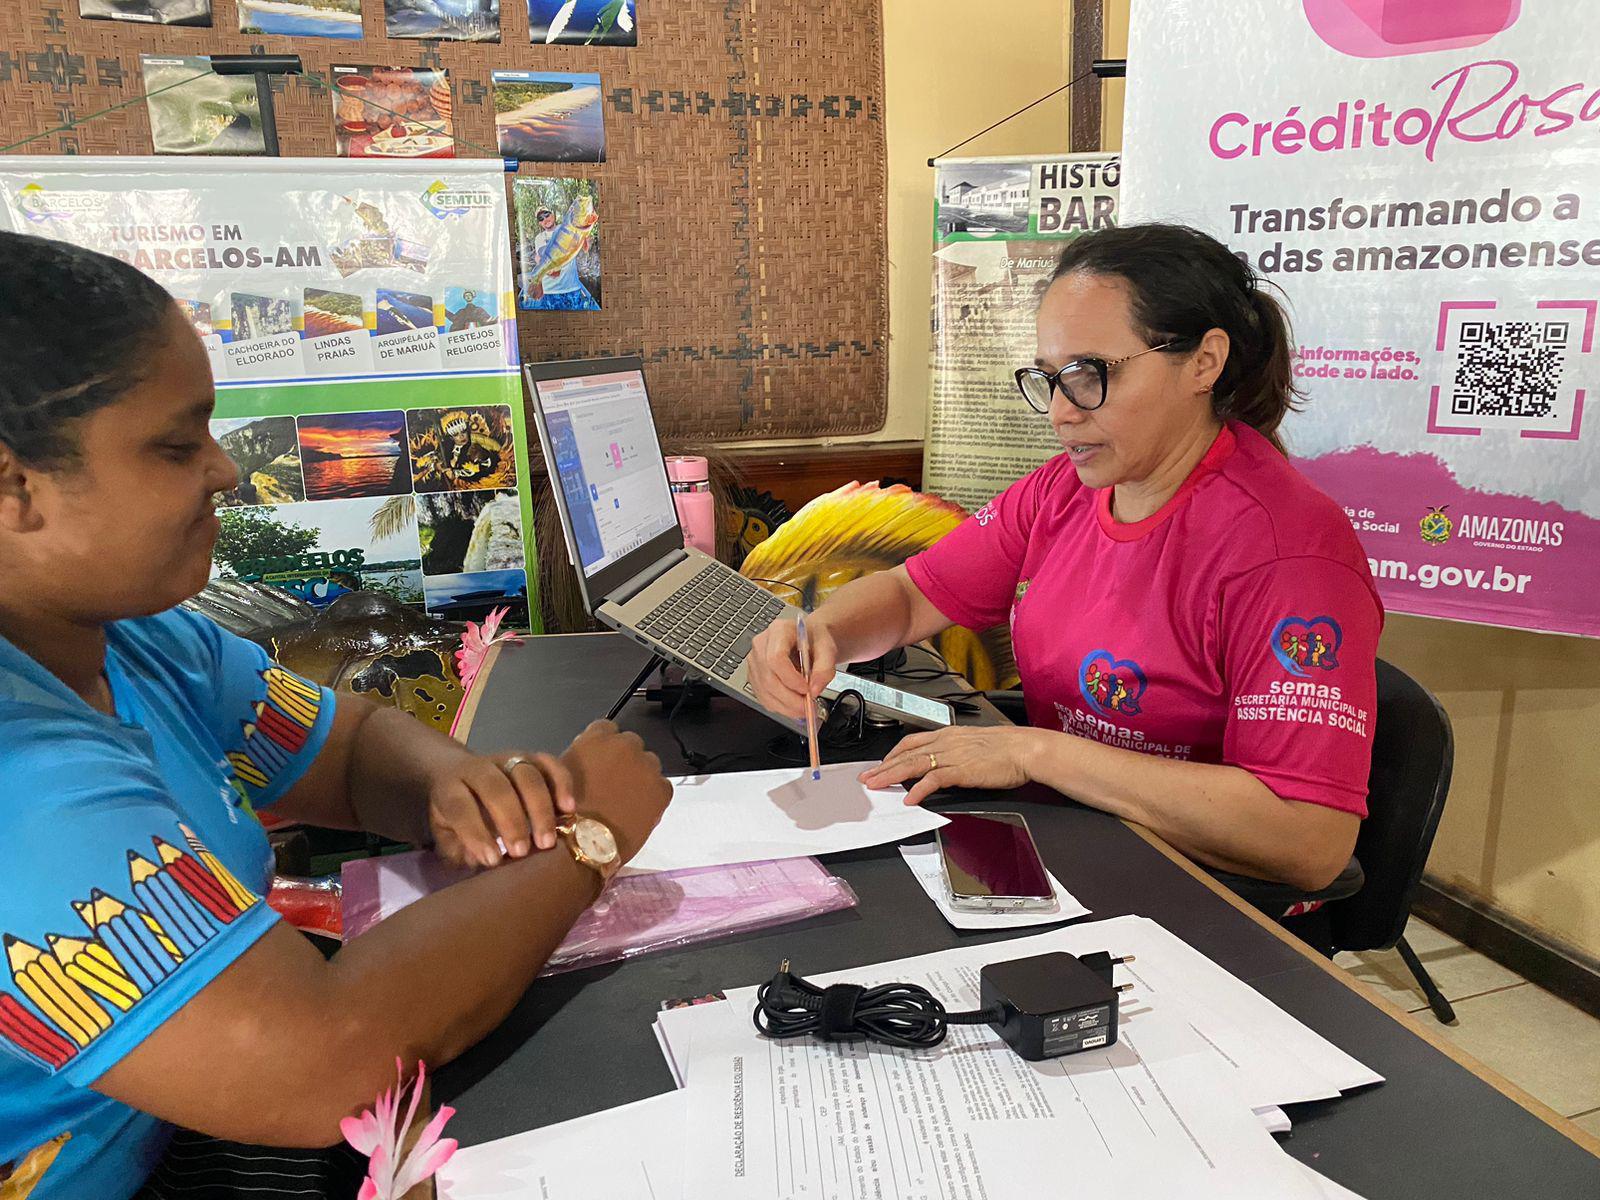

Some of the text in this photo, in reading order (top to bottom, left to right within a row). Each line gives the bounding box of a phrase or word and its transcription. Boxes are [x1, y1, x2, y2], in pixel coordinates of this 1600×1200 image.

[1209, 99, 1432, 160] Crédito
[437, 195, 493, 205] SEMTUR
[1229, 188, 1581, 234] Transformando a
[111, 225, 242, 242] TURISMO EM
[1001, 257, 1014, 268] De
[1258, 242, 1323, 273] das
[314, 336, 351, 350] LINDAS
[447, 329, 494, 344] FESTEJOS
[228, 340, 280, 356] CACHOEIRA
[281, 337, 295, 346] DO
[317, 347, 356, 362] PRAIAS
[380, 341, 436, 359] DE MARIUÁ
[446, 340, 502, 357] RELIGIOSOS
[1300, 345, 1422, 365] informações,
[236, 348, 295, 366] ELDORADO
[1292, 363, 1419, 380] Code ao lado.
[1358, 507, 1375, 519] de
[1362, 520, 1400, 534] Social
[1458, 514, 1564, 547] AMAZONAS
[1473, 541, 1505, 549] GOVERNO
[1517, 544, 1543, 553] ESTADO
[1269, 681, 1342, 700] semas
[1235, 694, 1367, 722] SECRETARIA MUNICIPAL DE
[1075, 709, 1145, 741] semas
[1237, 705, 1367, 738] ASSISTÊNCIA SOCIAL
[1102, 733, 1192, 753] MUNICIPAL DE
[1084, 1037, 1105, 1045] Lenovo
[733, 1086, 743, 1119] RESIDÊNCIA
[734, 1131, 744, 1176] DECLARAÇÃO
